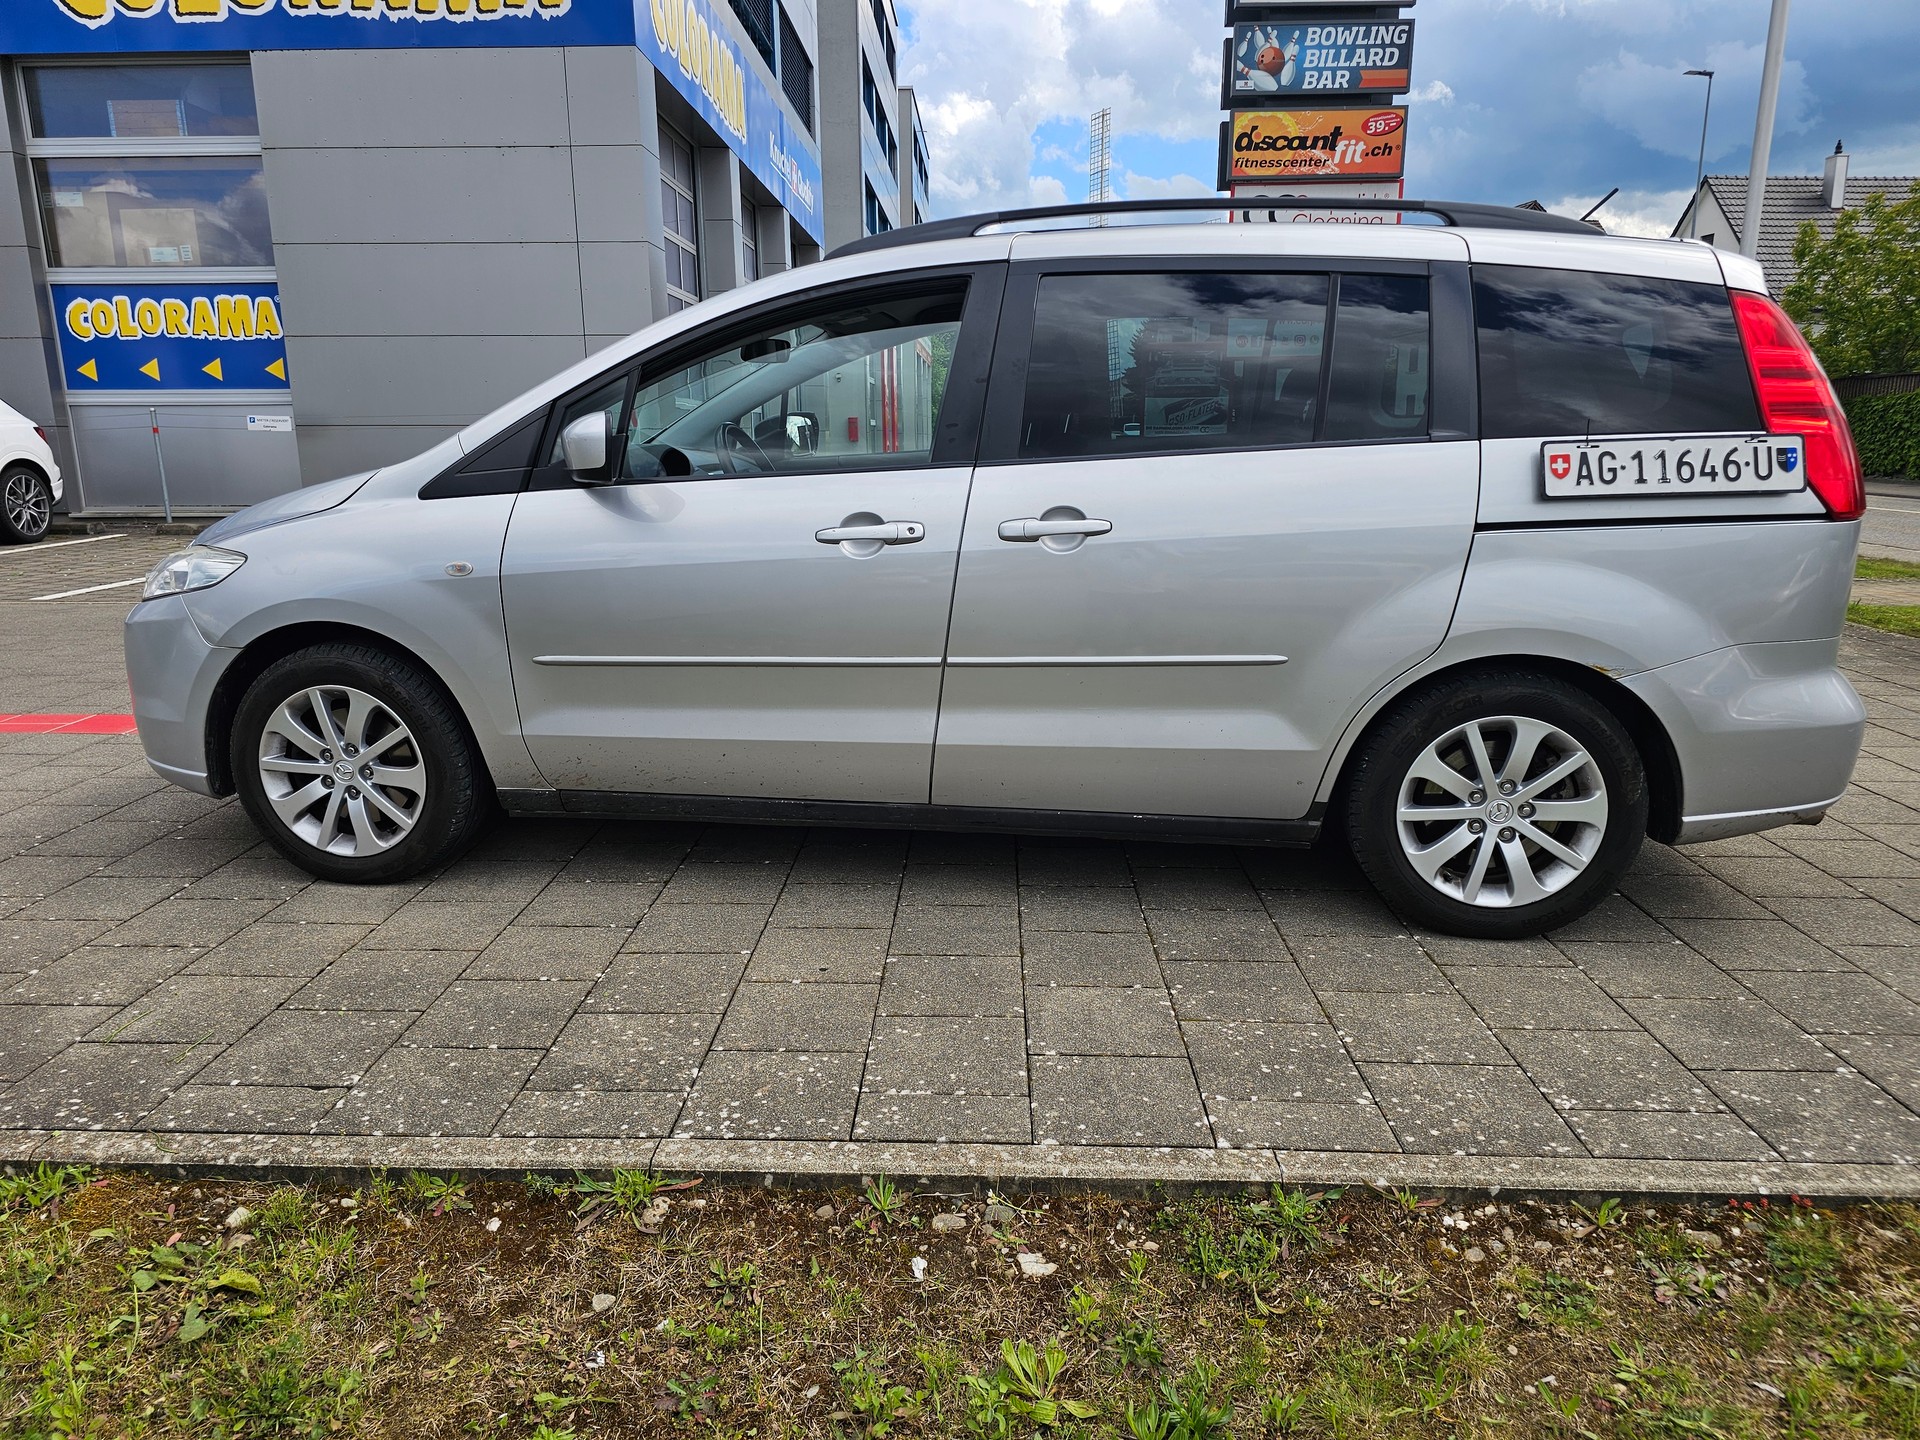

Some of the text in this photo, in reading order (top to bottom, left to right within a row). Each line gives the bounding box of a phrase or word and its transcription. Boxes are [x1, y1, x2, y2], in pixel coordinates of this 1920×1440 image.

[1304, 25, 1409, 46] BOWLING
[1303, 47, 1400, 68] BILLARD
[1302, 70, 1350, 89] BAR
[1234, 156, 1330, 169] fitnesscenter
[67, 295, 282, 340] COLORAMA
